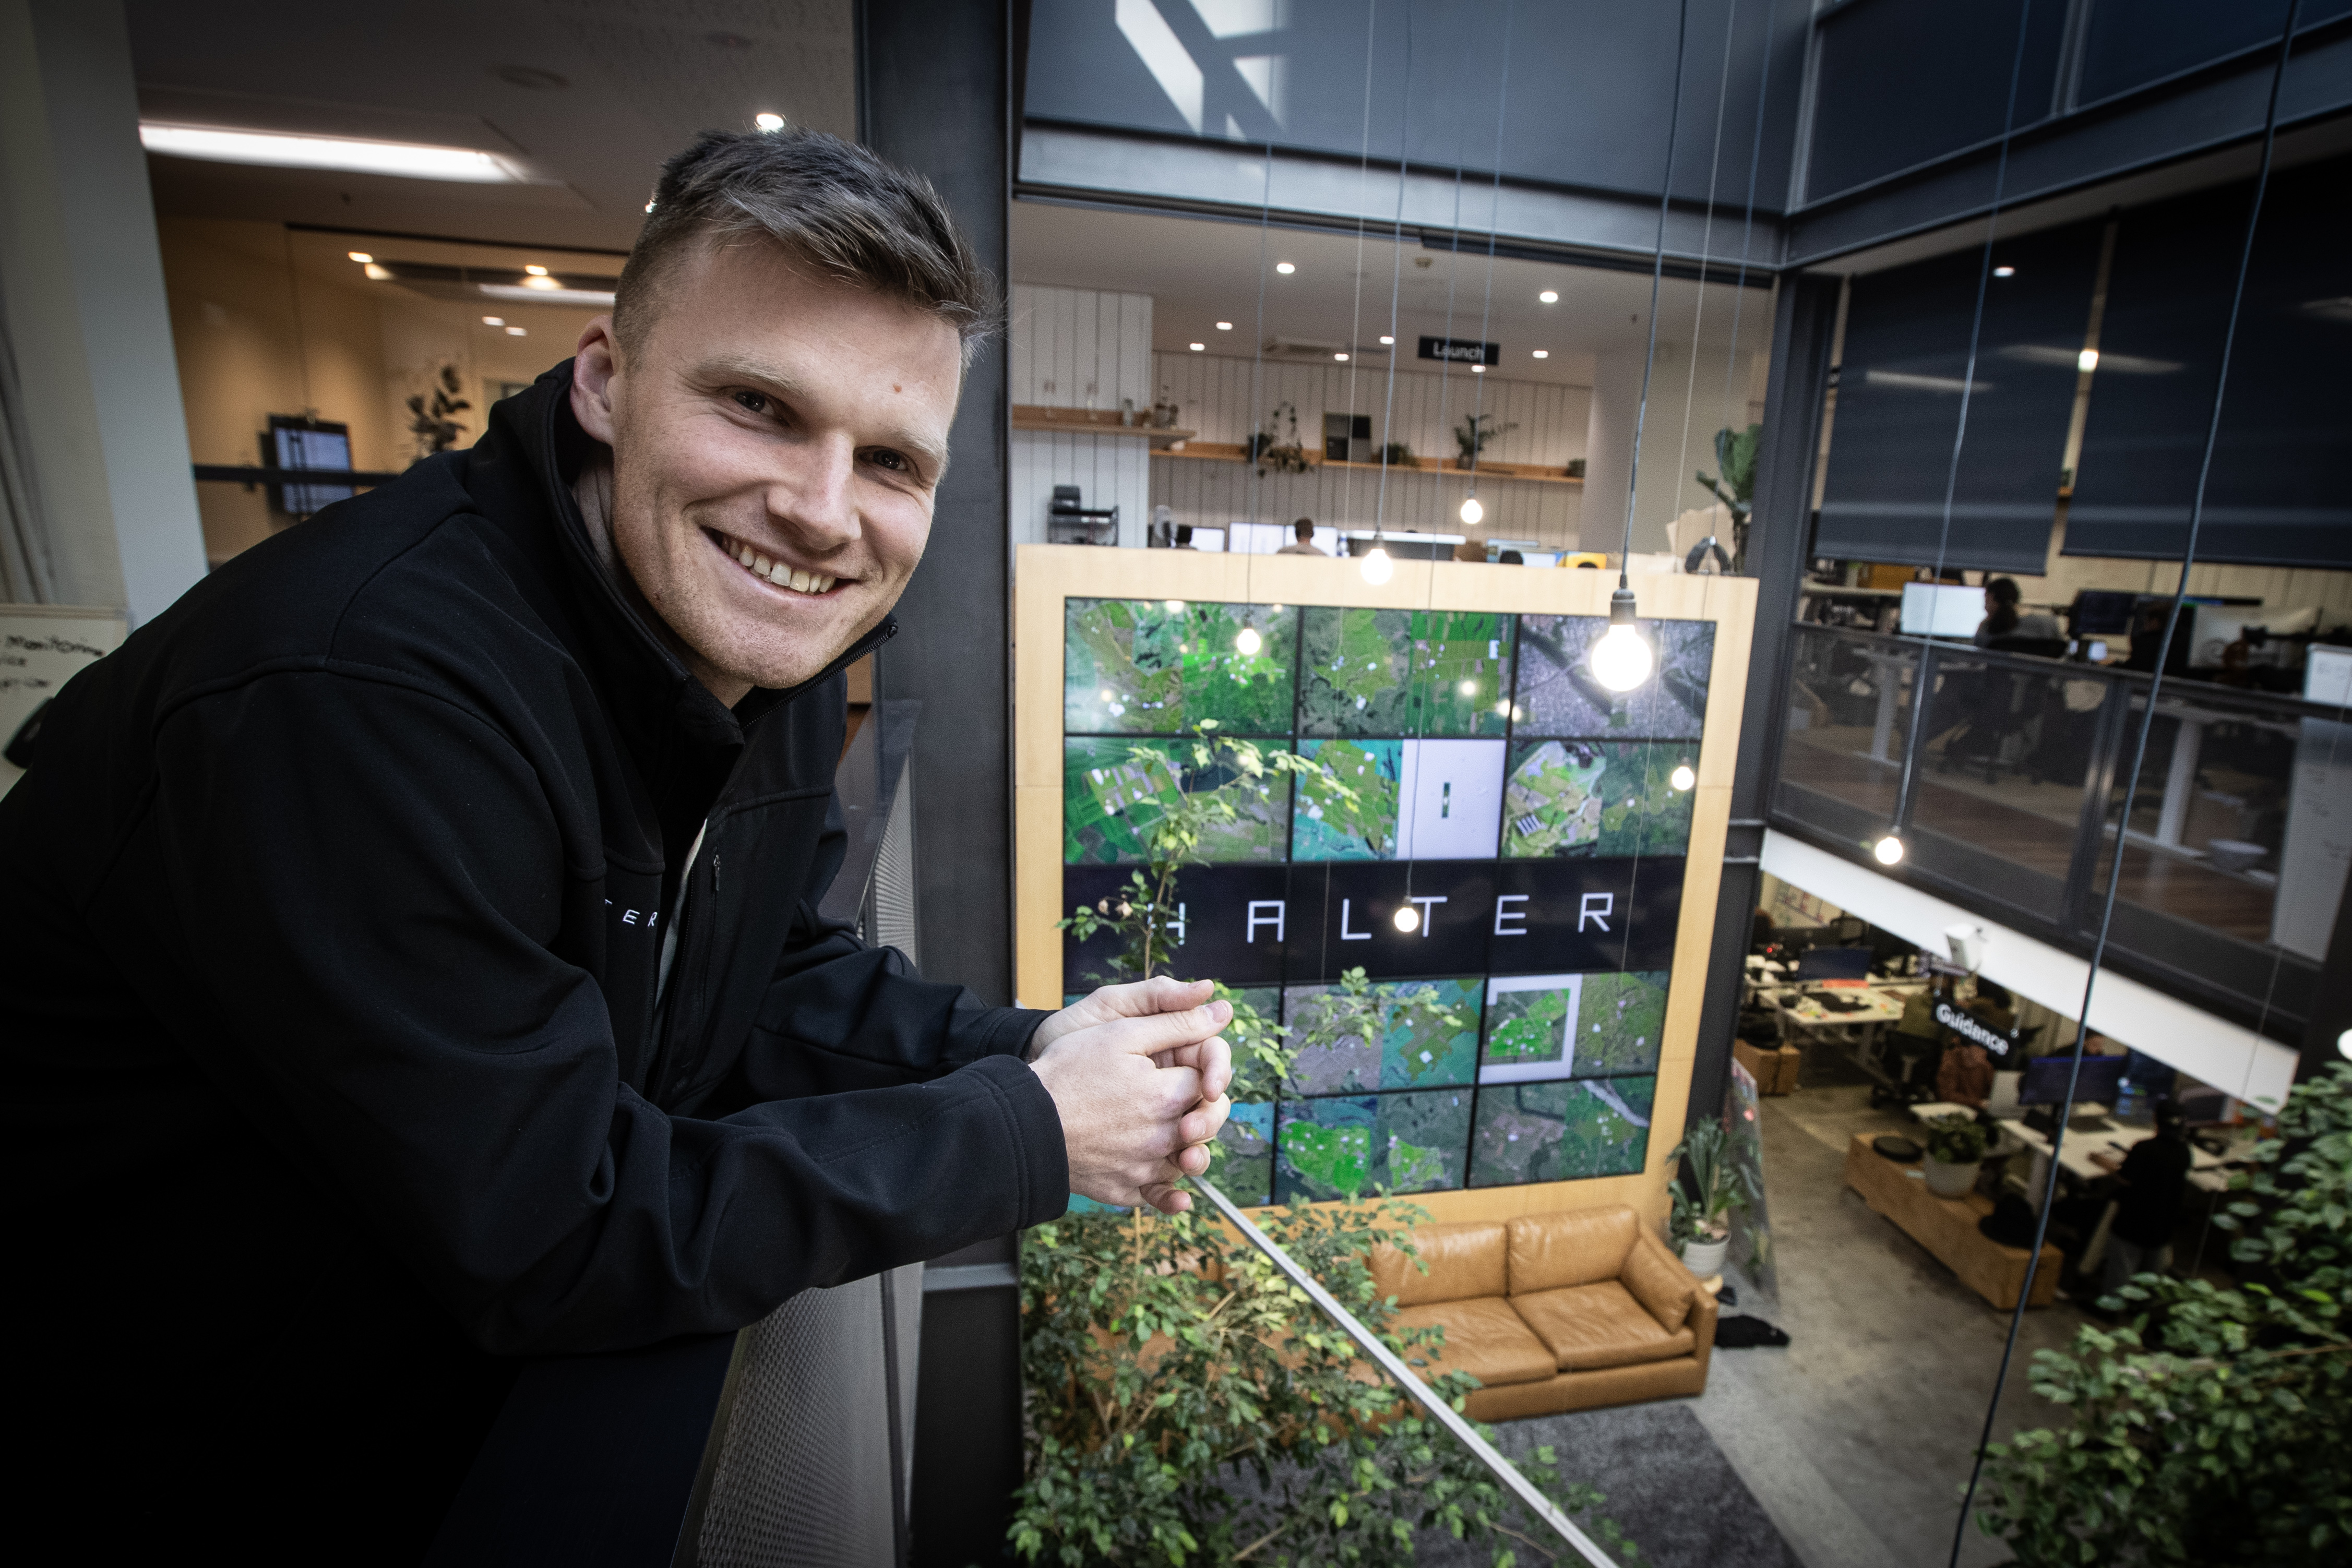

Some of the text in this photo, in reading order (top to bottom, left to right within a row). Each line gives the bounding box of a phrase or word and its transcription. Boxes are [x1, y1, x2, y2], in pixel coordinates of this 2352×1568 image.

[1433, 341, 1485, 361] Launch
[1148, 892, 1614, 945] HALTER
[1936, 1003, 2009, 1056] Guidance
